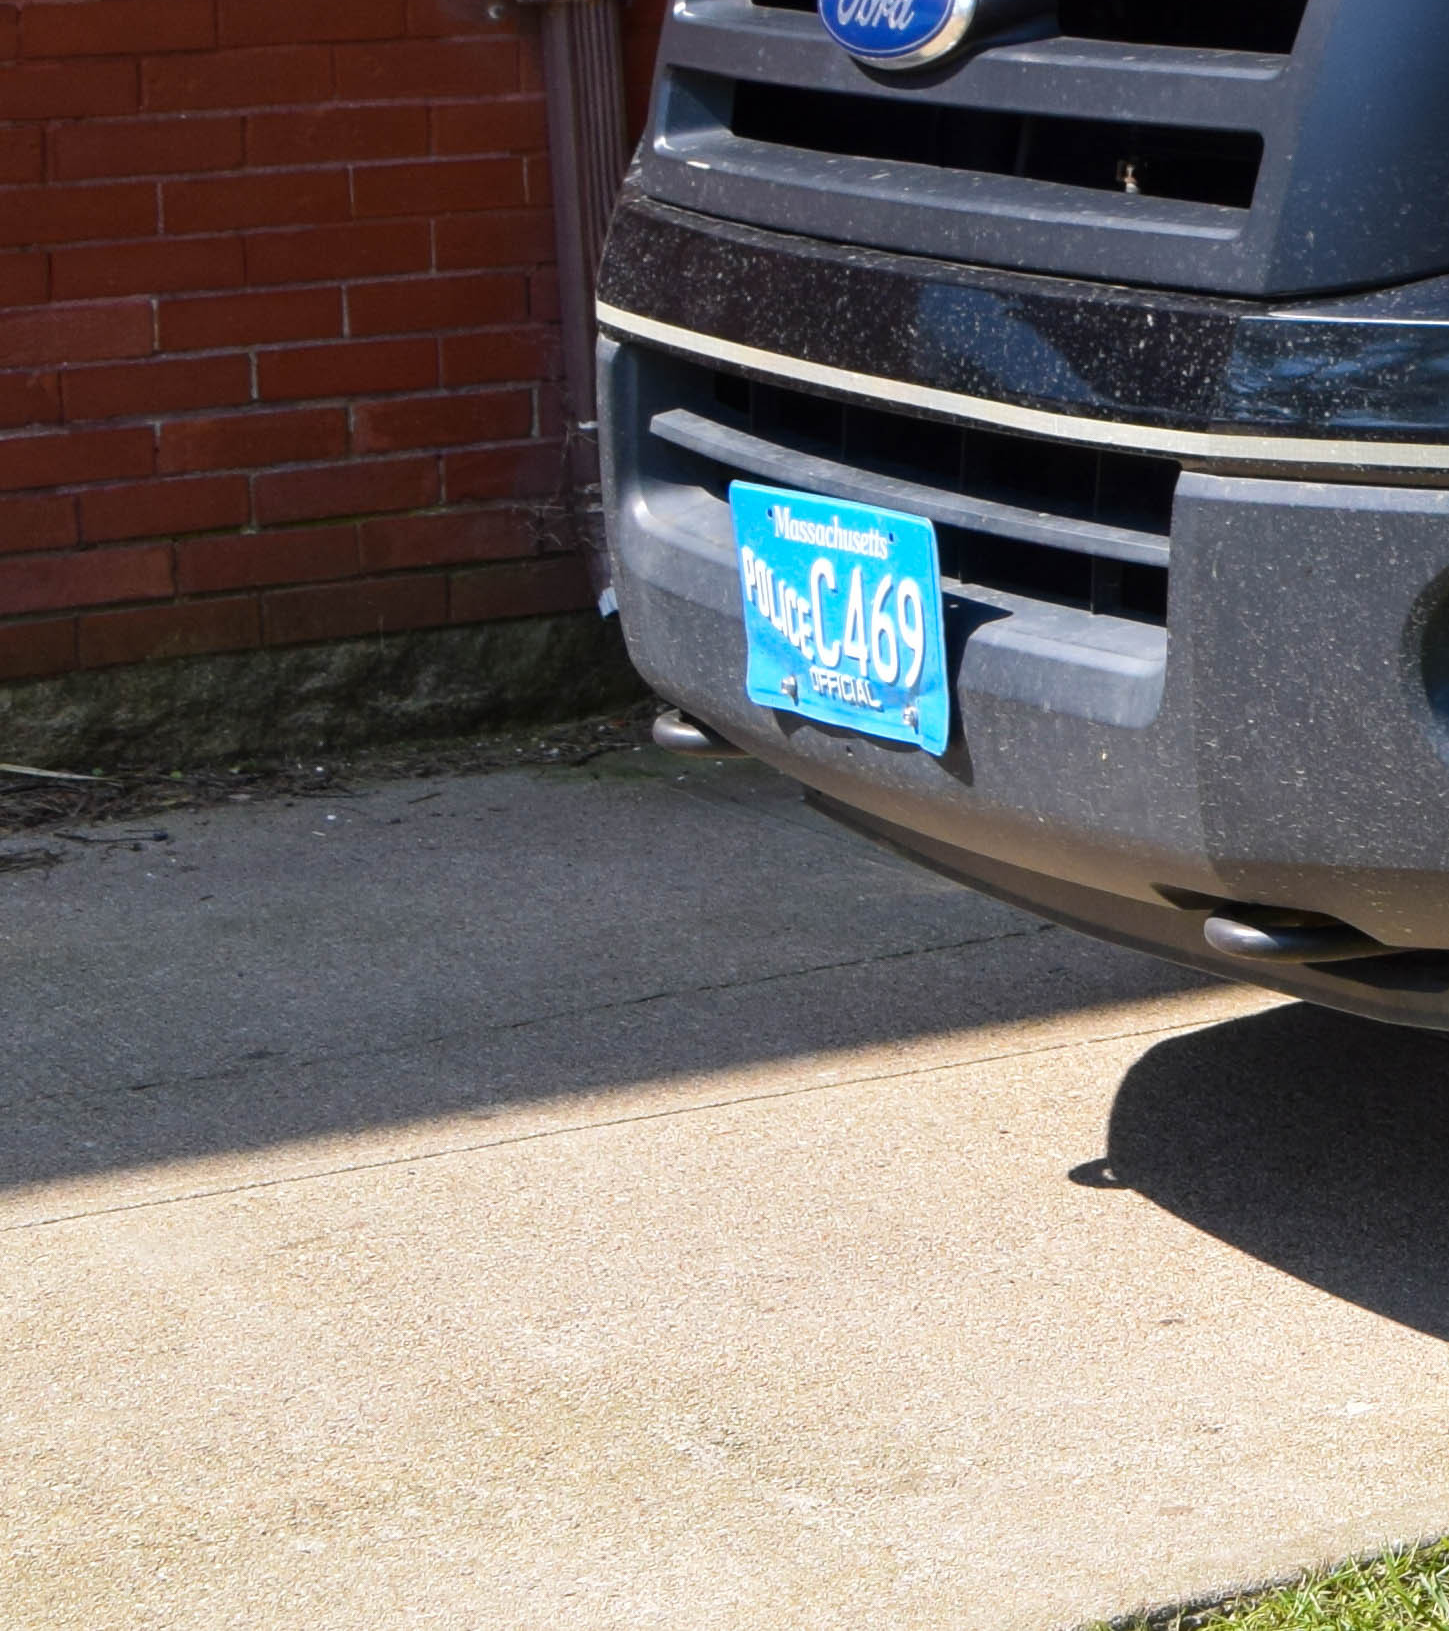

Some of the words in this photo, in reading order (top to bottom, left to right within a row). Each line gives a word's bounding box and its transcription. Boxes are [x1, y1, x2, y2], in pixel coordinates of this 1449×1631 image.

[773, 504, 889, 560] Massachusetts
[741, 546, 814, 661] POLICE
[810, 557, 924, 688] C469
[809, 666, 882, 708] OFFICIAL
